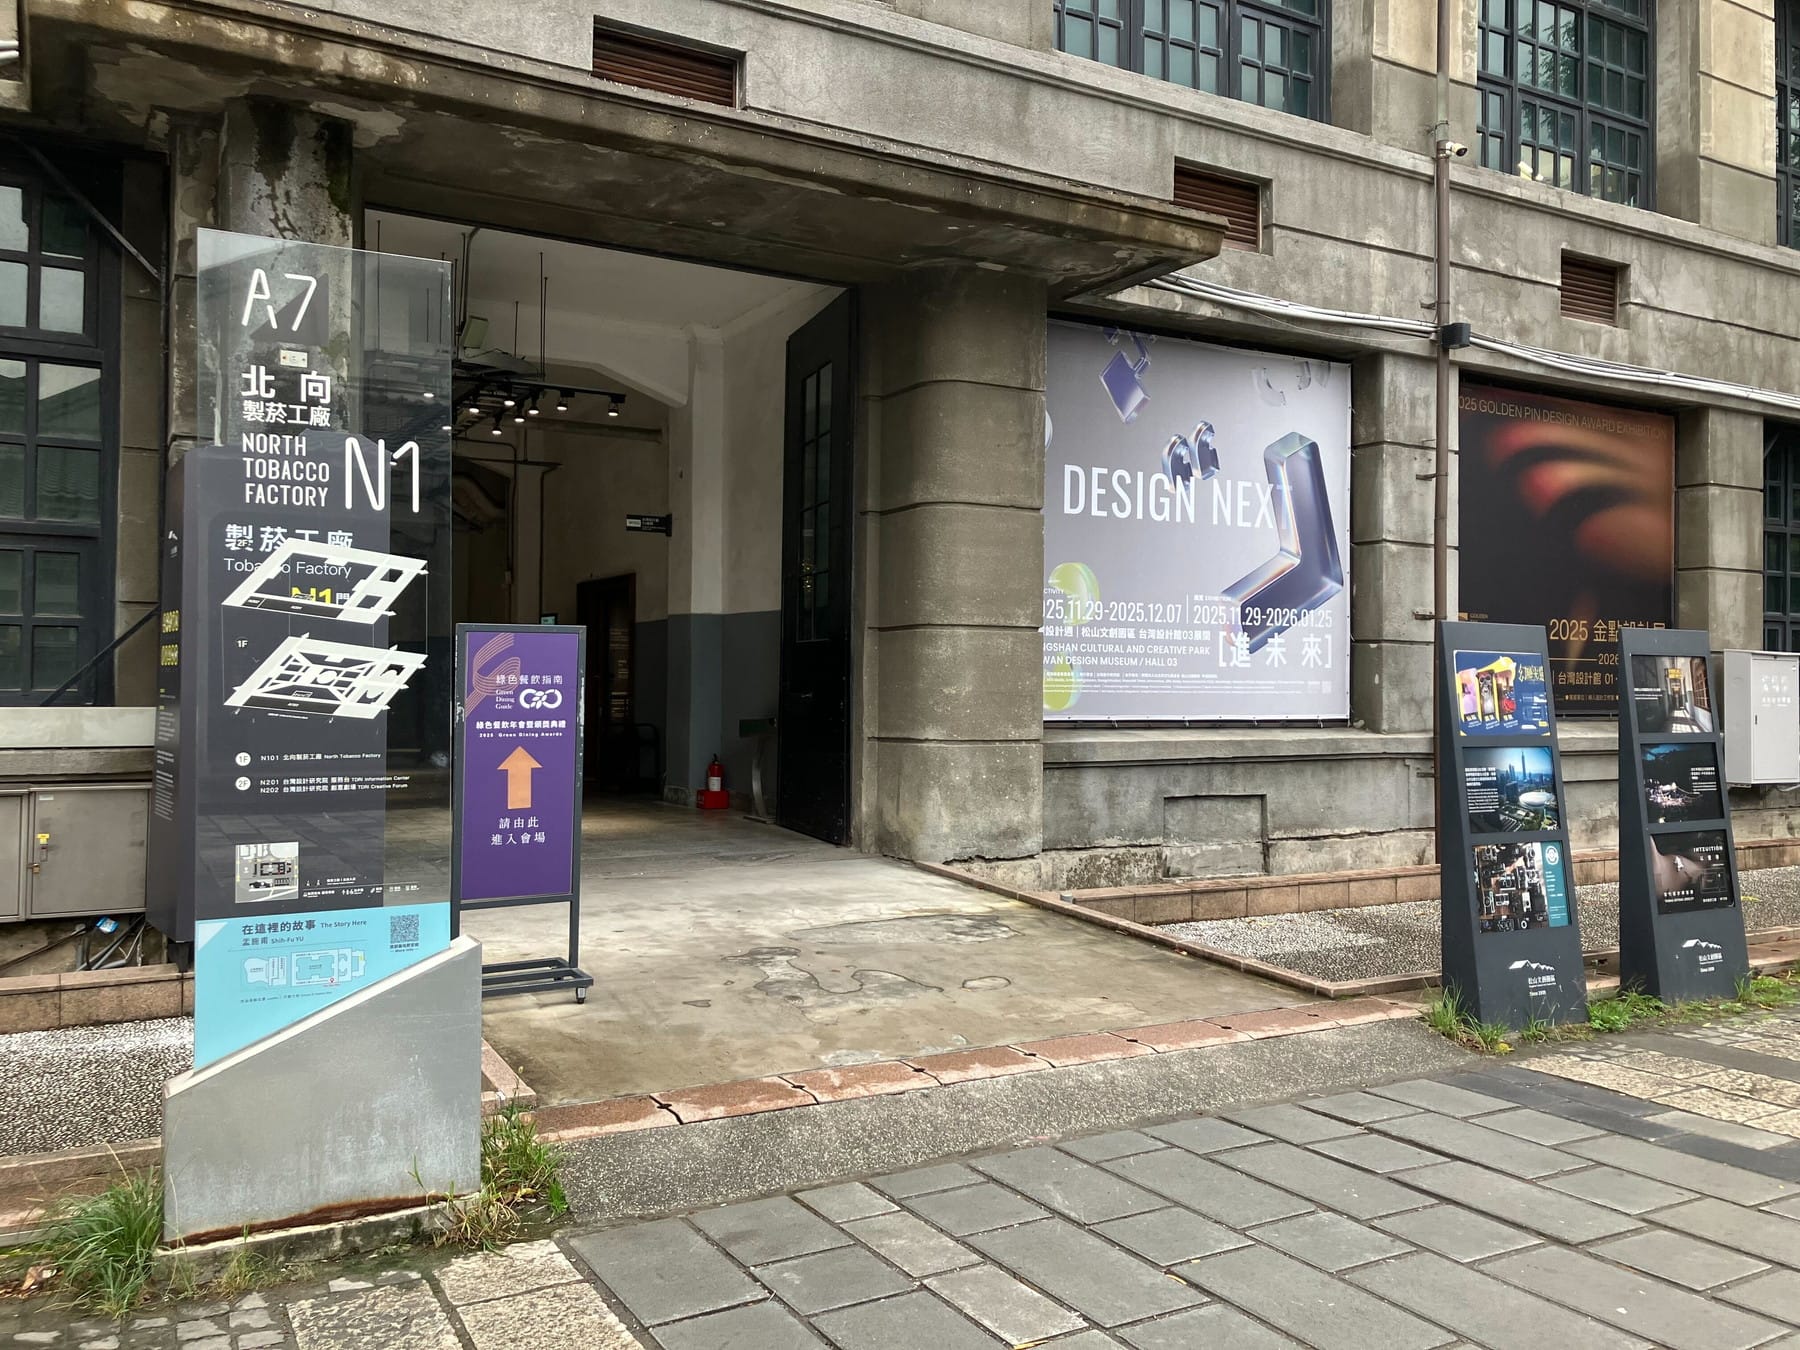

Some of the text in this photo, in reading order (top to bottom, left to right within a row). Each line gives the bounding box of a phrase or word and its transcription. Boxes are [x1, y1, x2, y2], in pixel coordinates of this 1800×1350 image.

[241, 268, 317, 332] A7
[240, 365, 331, 404] 北向
[242, 400, 331, 428] 製菸工廠
[1479, 399, 1523, 419] GOLDEN
[1524, 406, 1541, 421] PIN
[1542, 409, 1579, 426] DESIGN
[1581, 416, 1615, 433] AWARD
[241, 432, 307, 456] NORTH
[243, 457, 330, 482] TOBACCO
[344, 436, 420, 513] N1
[244, 483, 328, 507] FACTORY
[1063, 464, 1195, 524] DESIGN
[223, 557, 352, 579] Tobao Factory
[1043, 598, 1182, 624] 25.11.29-2025.12.07
[1193, 605, 1332, 628] 2025.11.29-2026.01.25
[1549, 618, 1589, 641] 2025
[237, 640, 248, 648] 1F
[1080, 643, 1125, 653] CULTURAL
[1126, 645, 1145, 654] AND
[1146, 645, 1188, 655] CREATIVE
[1189, 646, 1210, 655] PARK
[1066, 656, 1100, 665] DESIGN
[1101, 657, 1138, 666] MUSEUM
[1145, 657, 1165, 666] HALL
[1167, 657, 1178, 666] 03
[1604, 673, 1614, 685] 01
[498, 815, 539, 830] 請由此
[490, 831, 546, 846] 進入會場
[242, 919, 317, 935] 在這裡的故事
[334, 921, 351, 929] Story
[351, 919, 368, 927] Here
